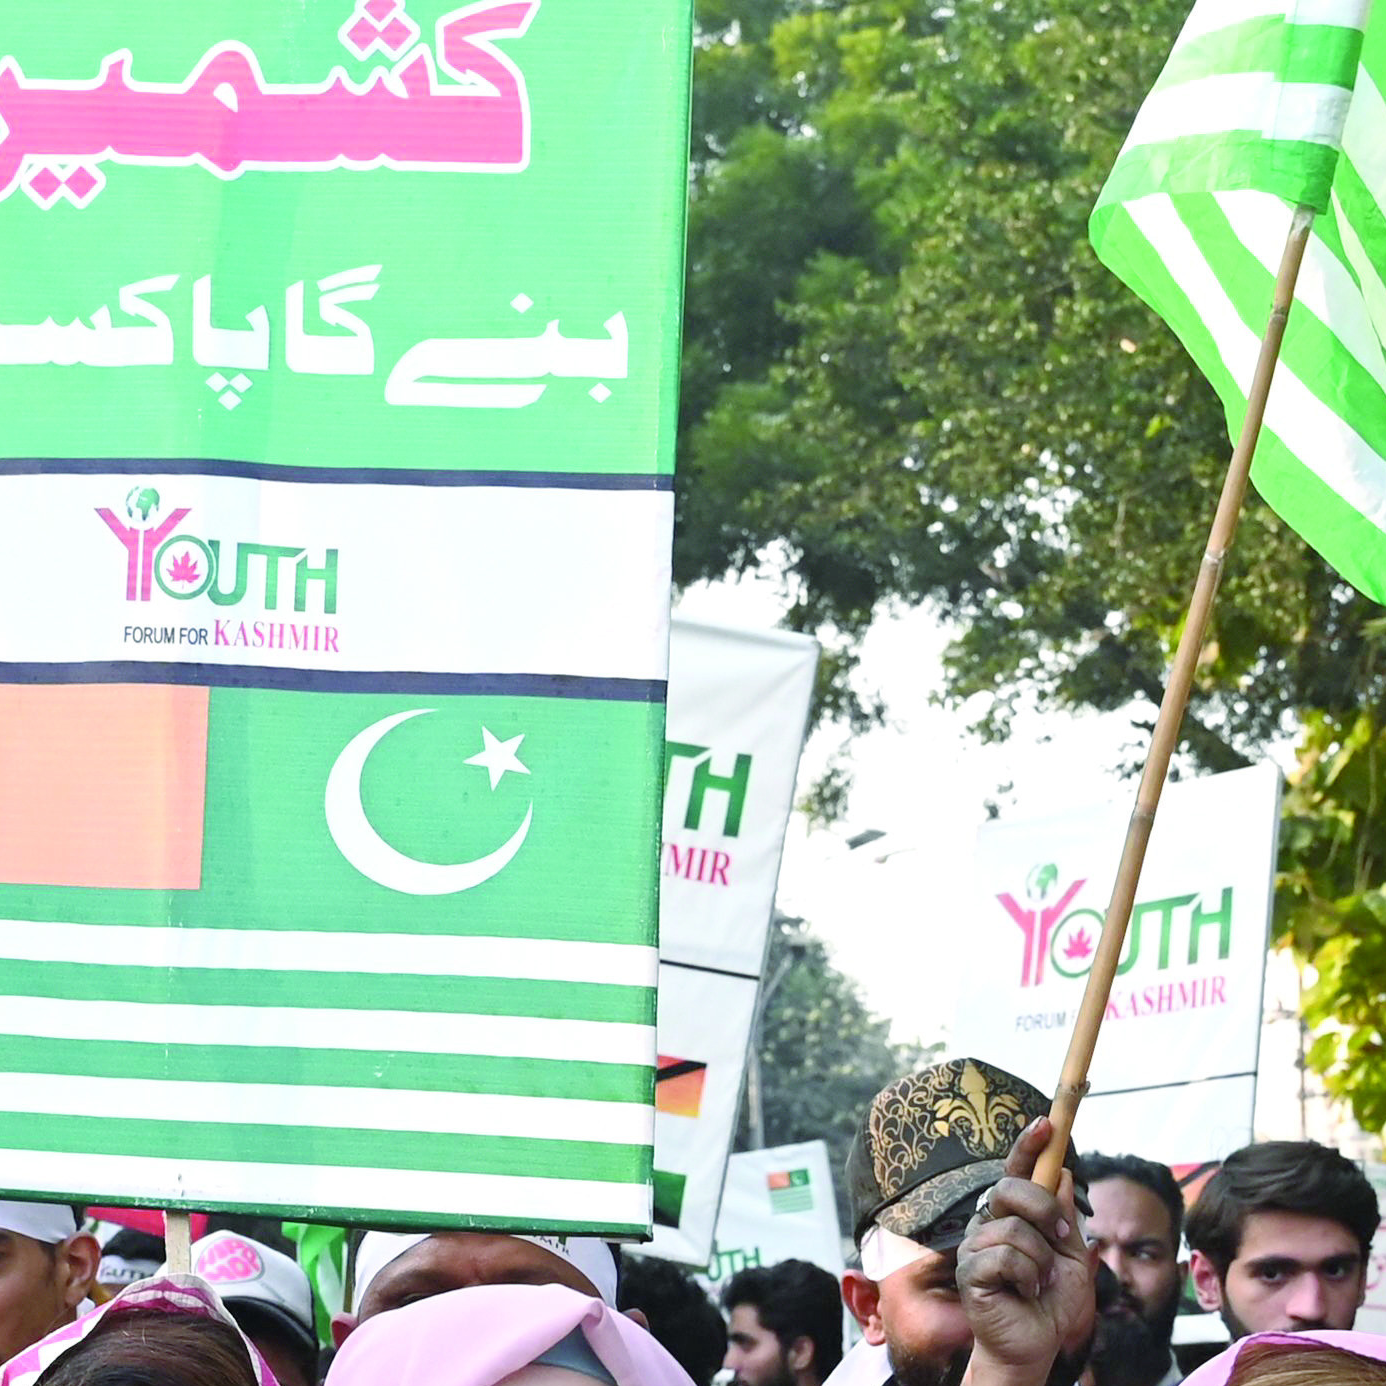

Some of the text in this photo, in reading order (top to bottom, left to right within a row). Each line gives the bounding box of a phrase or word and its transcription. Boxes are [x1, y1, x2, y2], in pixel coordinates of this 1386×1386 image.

[284, 264, 384, 377] گا
[384, 291, 629, 408] بنے
[94, 507, 339, 615] YOUTH
[123, 618, 340, 654] FORUM FOR KASHMIR
